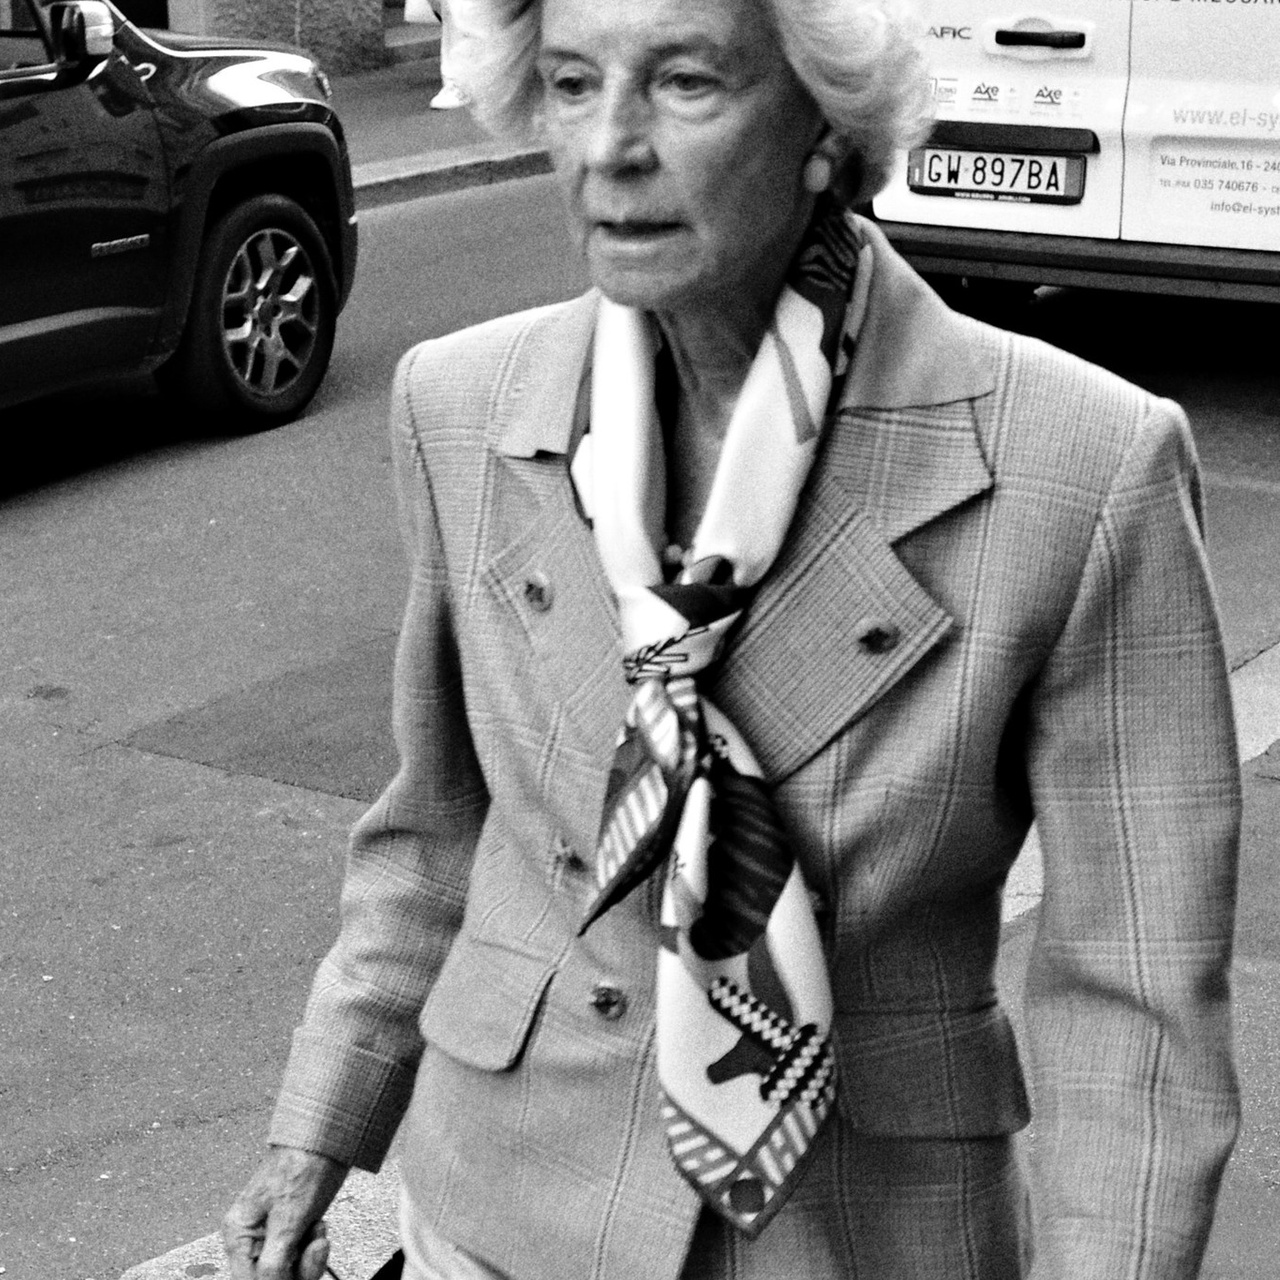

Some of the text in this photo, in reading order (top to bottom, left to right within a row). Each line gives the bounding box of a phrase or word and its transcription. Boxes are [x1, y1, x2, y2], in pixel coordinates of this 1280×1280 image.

[1160, 154, 1176, 167] Via
[928, 154, 1060, 192] GW 897BA
[1194, 178, 1214, 190] 035
[1218, 180, 1259, 193] 740676
